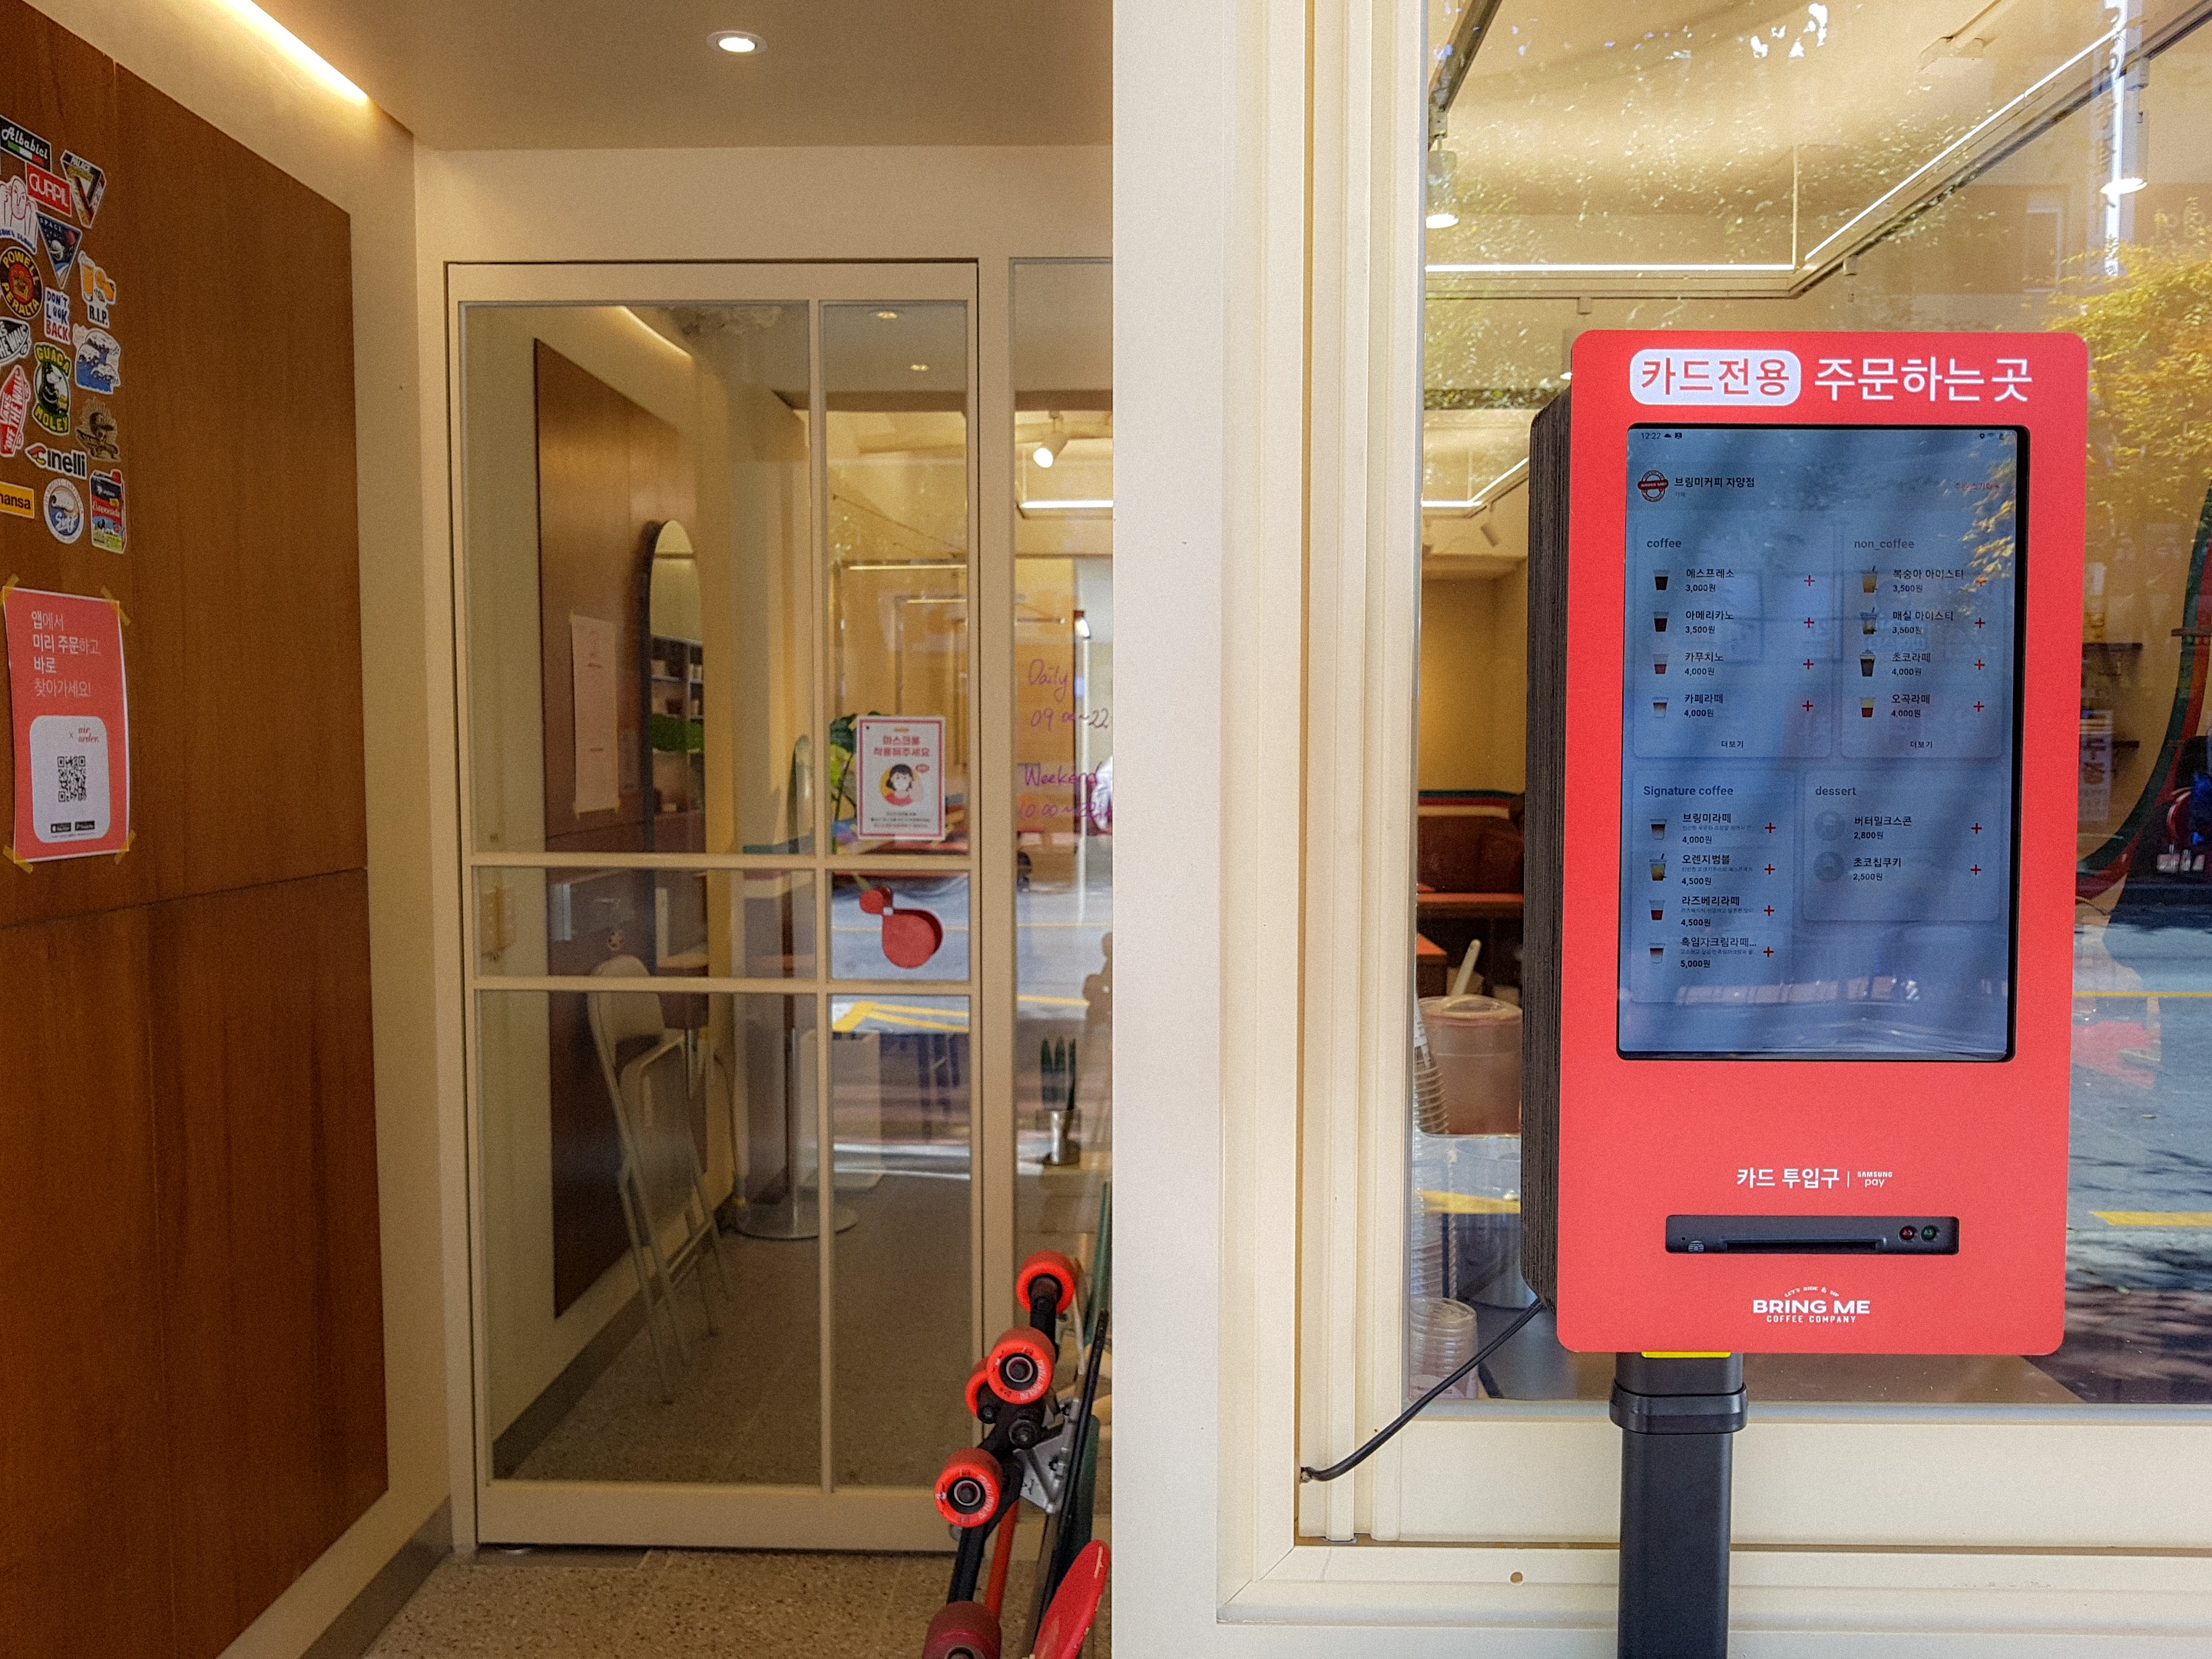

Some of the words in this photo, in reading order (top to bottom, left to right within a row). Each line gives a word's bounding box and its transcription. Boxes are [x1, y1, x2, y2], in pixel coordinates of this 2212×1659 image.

[2, 126, 48, 160] Albabici
[2, 250, 40, 285] POWELL
[2, 282, 40, 316] PERALTA
[47, 290, 68, 306] DON'T
[46, 304, 68, 325] LOOK
[46, 320, 69, 341] BACK
[1641, 358, 1790, 396] 카드전용
[1641, 432, 1661, 440] 12:22
[1674, 476, 1724, 488] 브링미커피
[1726, 476, 1755, 488] 자양점
[1647, 537, 1682, 548] coffee
[1854, 538, 1915, 551] non_coffee
[1686, 568, 1735, 579] 에스프레소
[1892, 569, 1922, 580] 복숭아
[1926, 569, 1965, 580] 아이스티
[1685, 584, 1717, 593] 3,000원
[1892, 584, 1923, 593] 3,500원
[1685, 610, 1734, 621] 아메리카노
[1892, 611, 1912, 621] 매실
[31, 611, 64, 631] 앱에서
[1685, 626, 1716, 635] 3,500원
[1892, 627, 1922, 635] 3,500원
[33, 634, 55, 653] 미리
[1685, 651, 1724, 663] 카푸치노
[1892, 652, 1931, 663] 초코라떼
[34, 656, 57, 674] 바로
[1684, 667, 1715, 677] 4,000원
[1892, 668, 1922, 677] 4,000원
[1684, 694, 1724, 704] 카페라떼
[1891, 694, 1931, 704] 오곡라떼
[1684, 709, 1714, 718] 4,000원
[1891, 710, 1922, 719] 4,000원
[1720, 740, 1744, 749] 더보기
[1909, 740, 1933, 749] 더보기
[1643, 786, 1696, 797] Signature
[1698, 785, 1734, 796] coffee
[1815, 786, 1856, 796] dessert
[1682, 813, 1732, 823] 브링미라떼
[1854, 816, 1912, 826] 버터밀크스콘
[1682, 836, 1713, 845] 4,000원
[1853, 831, 1884, 840] 2,800원
[1682, 854, 1731, 865] 오렌지범블
[1853, 857, 1902, 868] 초코칩쿠키
[1681, 877, 1712, 886] 4,500원
[1853, 873, 1883, 882] 2,500원
[1681, 896, 1740, 906] 라즈베리라떼
[1681, 919, 1711, 927] 4,500원
[1681, 960, 1710, 969] 5,000원
[1737, 1168, 1776, 1188] 카드
[1781, 1168, 1840, 1189] 투입구
[1865, 1178, 1886, 1188] pay
[1753, 1300, 1826, 1314] BRING
[1833, 1300, 1871, 1314] ME
[1767, 1315, 1803, 1323] COFFEE
